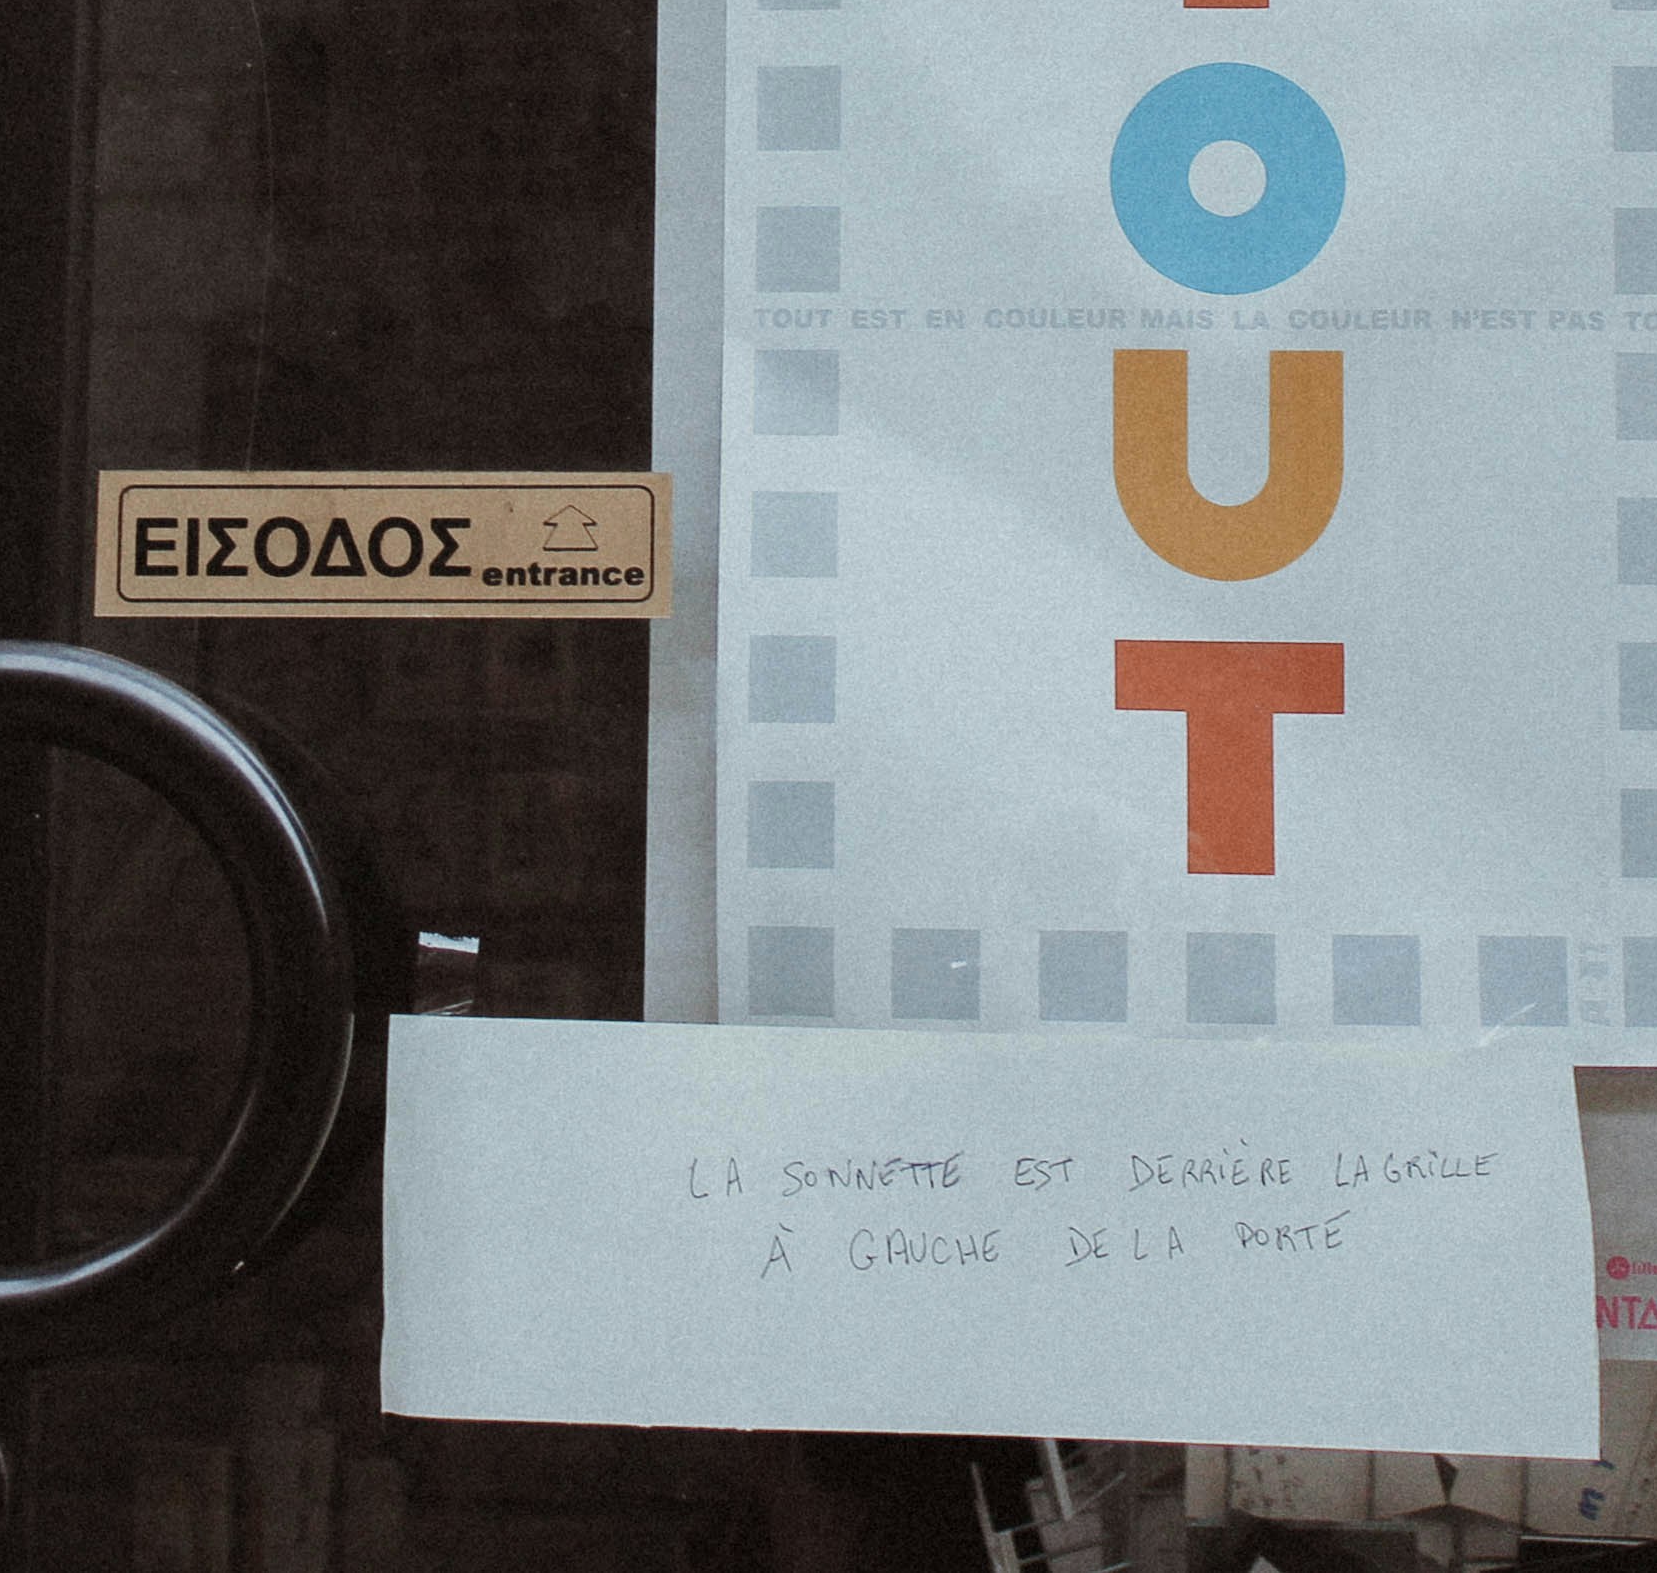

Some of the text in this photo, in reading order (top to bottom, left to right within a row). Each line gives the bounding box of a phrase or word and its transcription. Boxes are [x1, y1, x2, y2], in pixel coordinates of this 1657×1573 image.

[754, 308, 832, 329] TOUT
[851, 308, 905, 330] EST
[925, 309, 966, 331] EN
[984, 307, 1126, 331] COULEUR
[1141, 308, 1213, 331] MAIS
[1232, 309, 1270, 331] LA
[1288, 308, 1432, 331] COULEUR
[1451, 308, 1536, 331] N'EST
[1549, 309, 1603, 332] PAS
[135, 517, 472, 578] ΕΙΣΟΔΟΣ
[482, 562, 644, 586] entrance
[690, 1157, 742, 1198] LA
[782, 1150, 966, 1197] SONNETTE
[1015, 1157, 1073, 1191] EST
[761, 1223, 791, 1278] À
[850, 1228, 1000, 1270] GAUCHE
[1065, 1227, 1110, 1267] DE
[1133, 1226, 1184, 1260] LA
